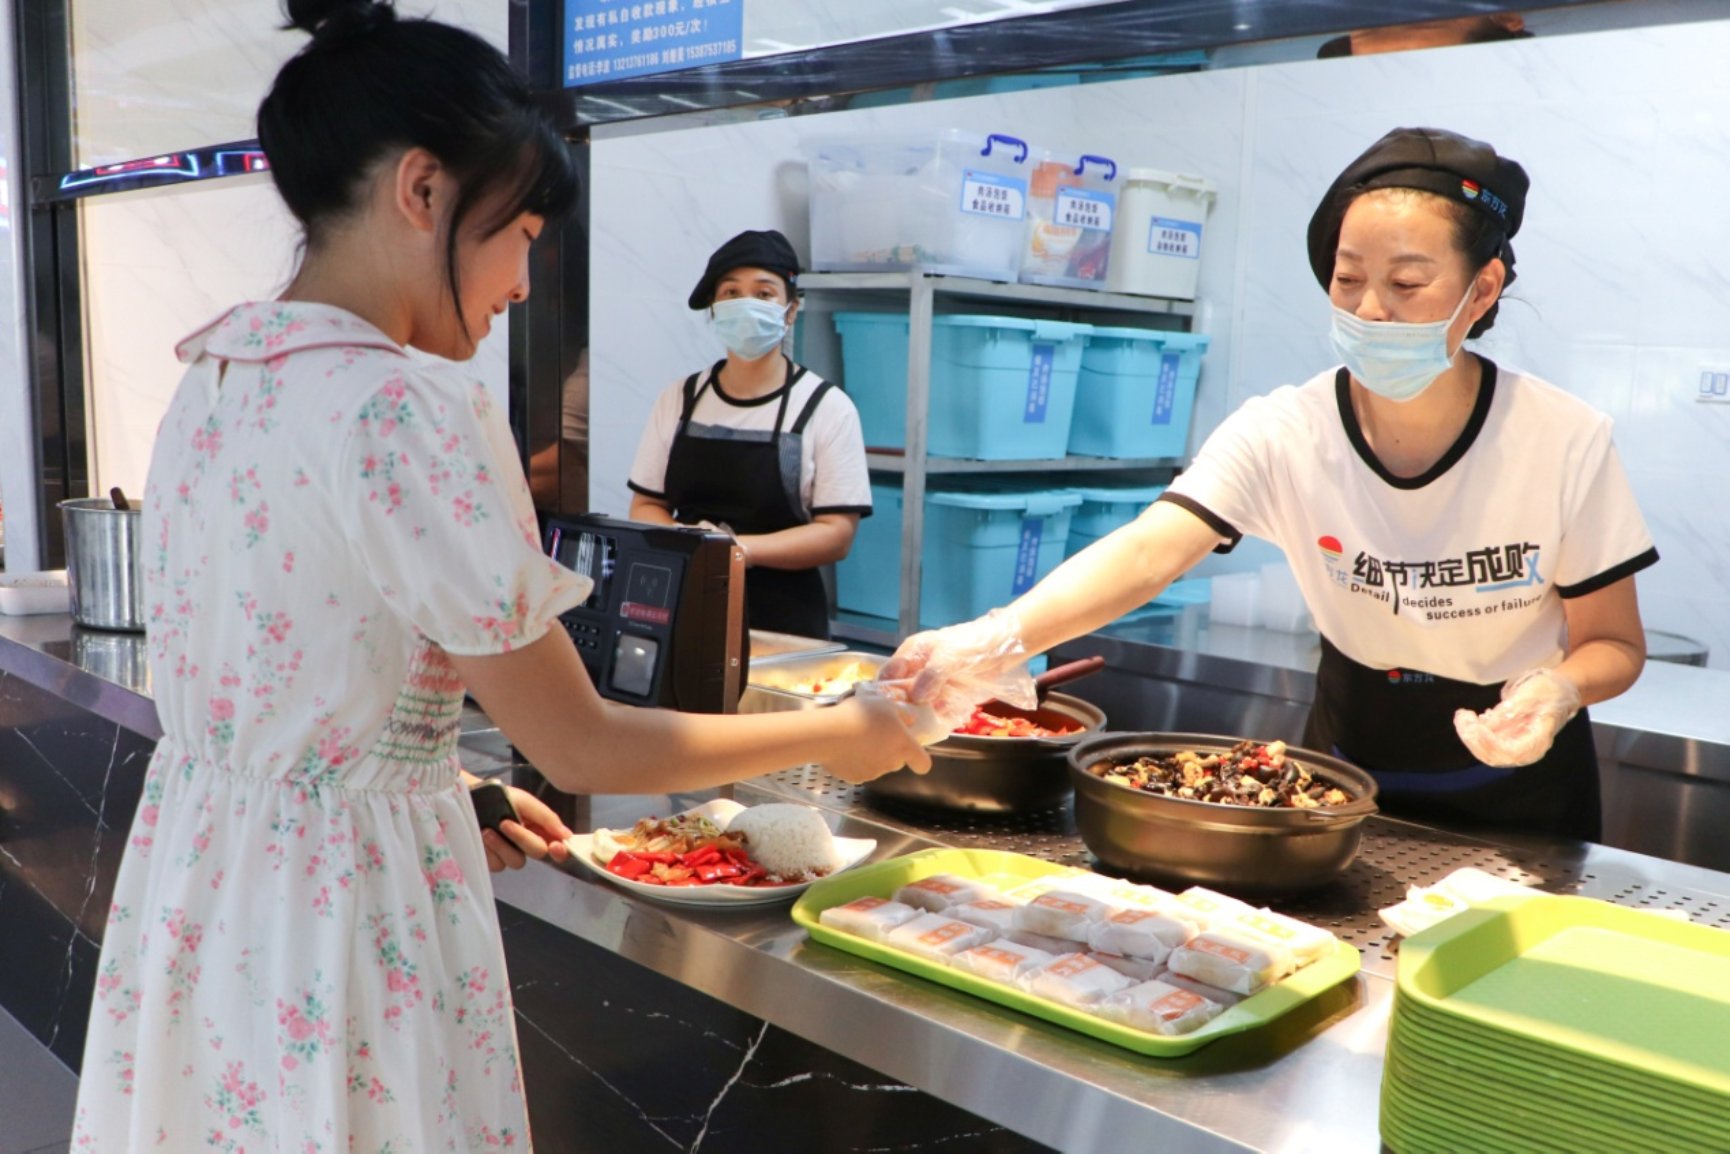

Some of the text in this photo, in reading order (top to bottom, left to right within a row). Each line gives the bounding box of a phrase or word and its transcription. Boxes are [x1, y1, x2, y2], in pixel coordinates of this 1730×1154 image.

[1350, 584, 1453, 608] Detail decides
[1426, 607, 1481, 620] success
[1484, 604, 1498, 615] or
